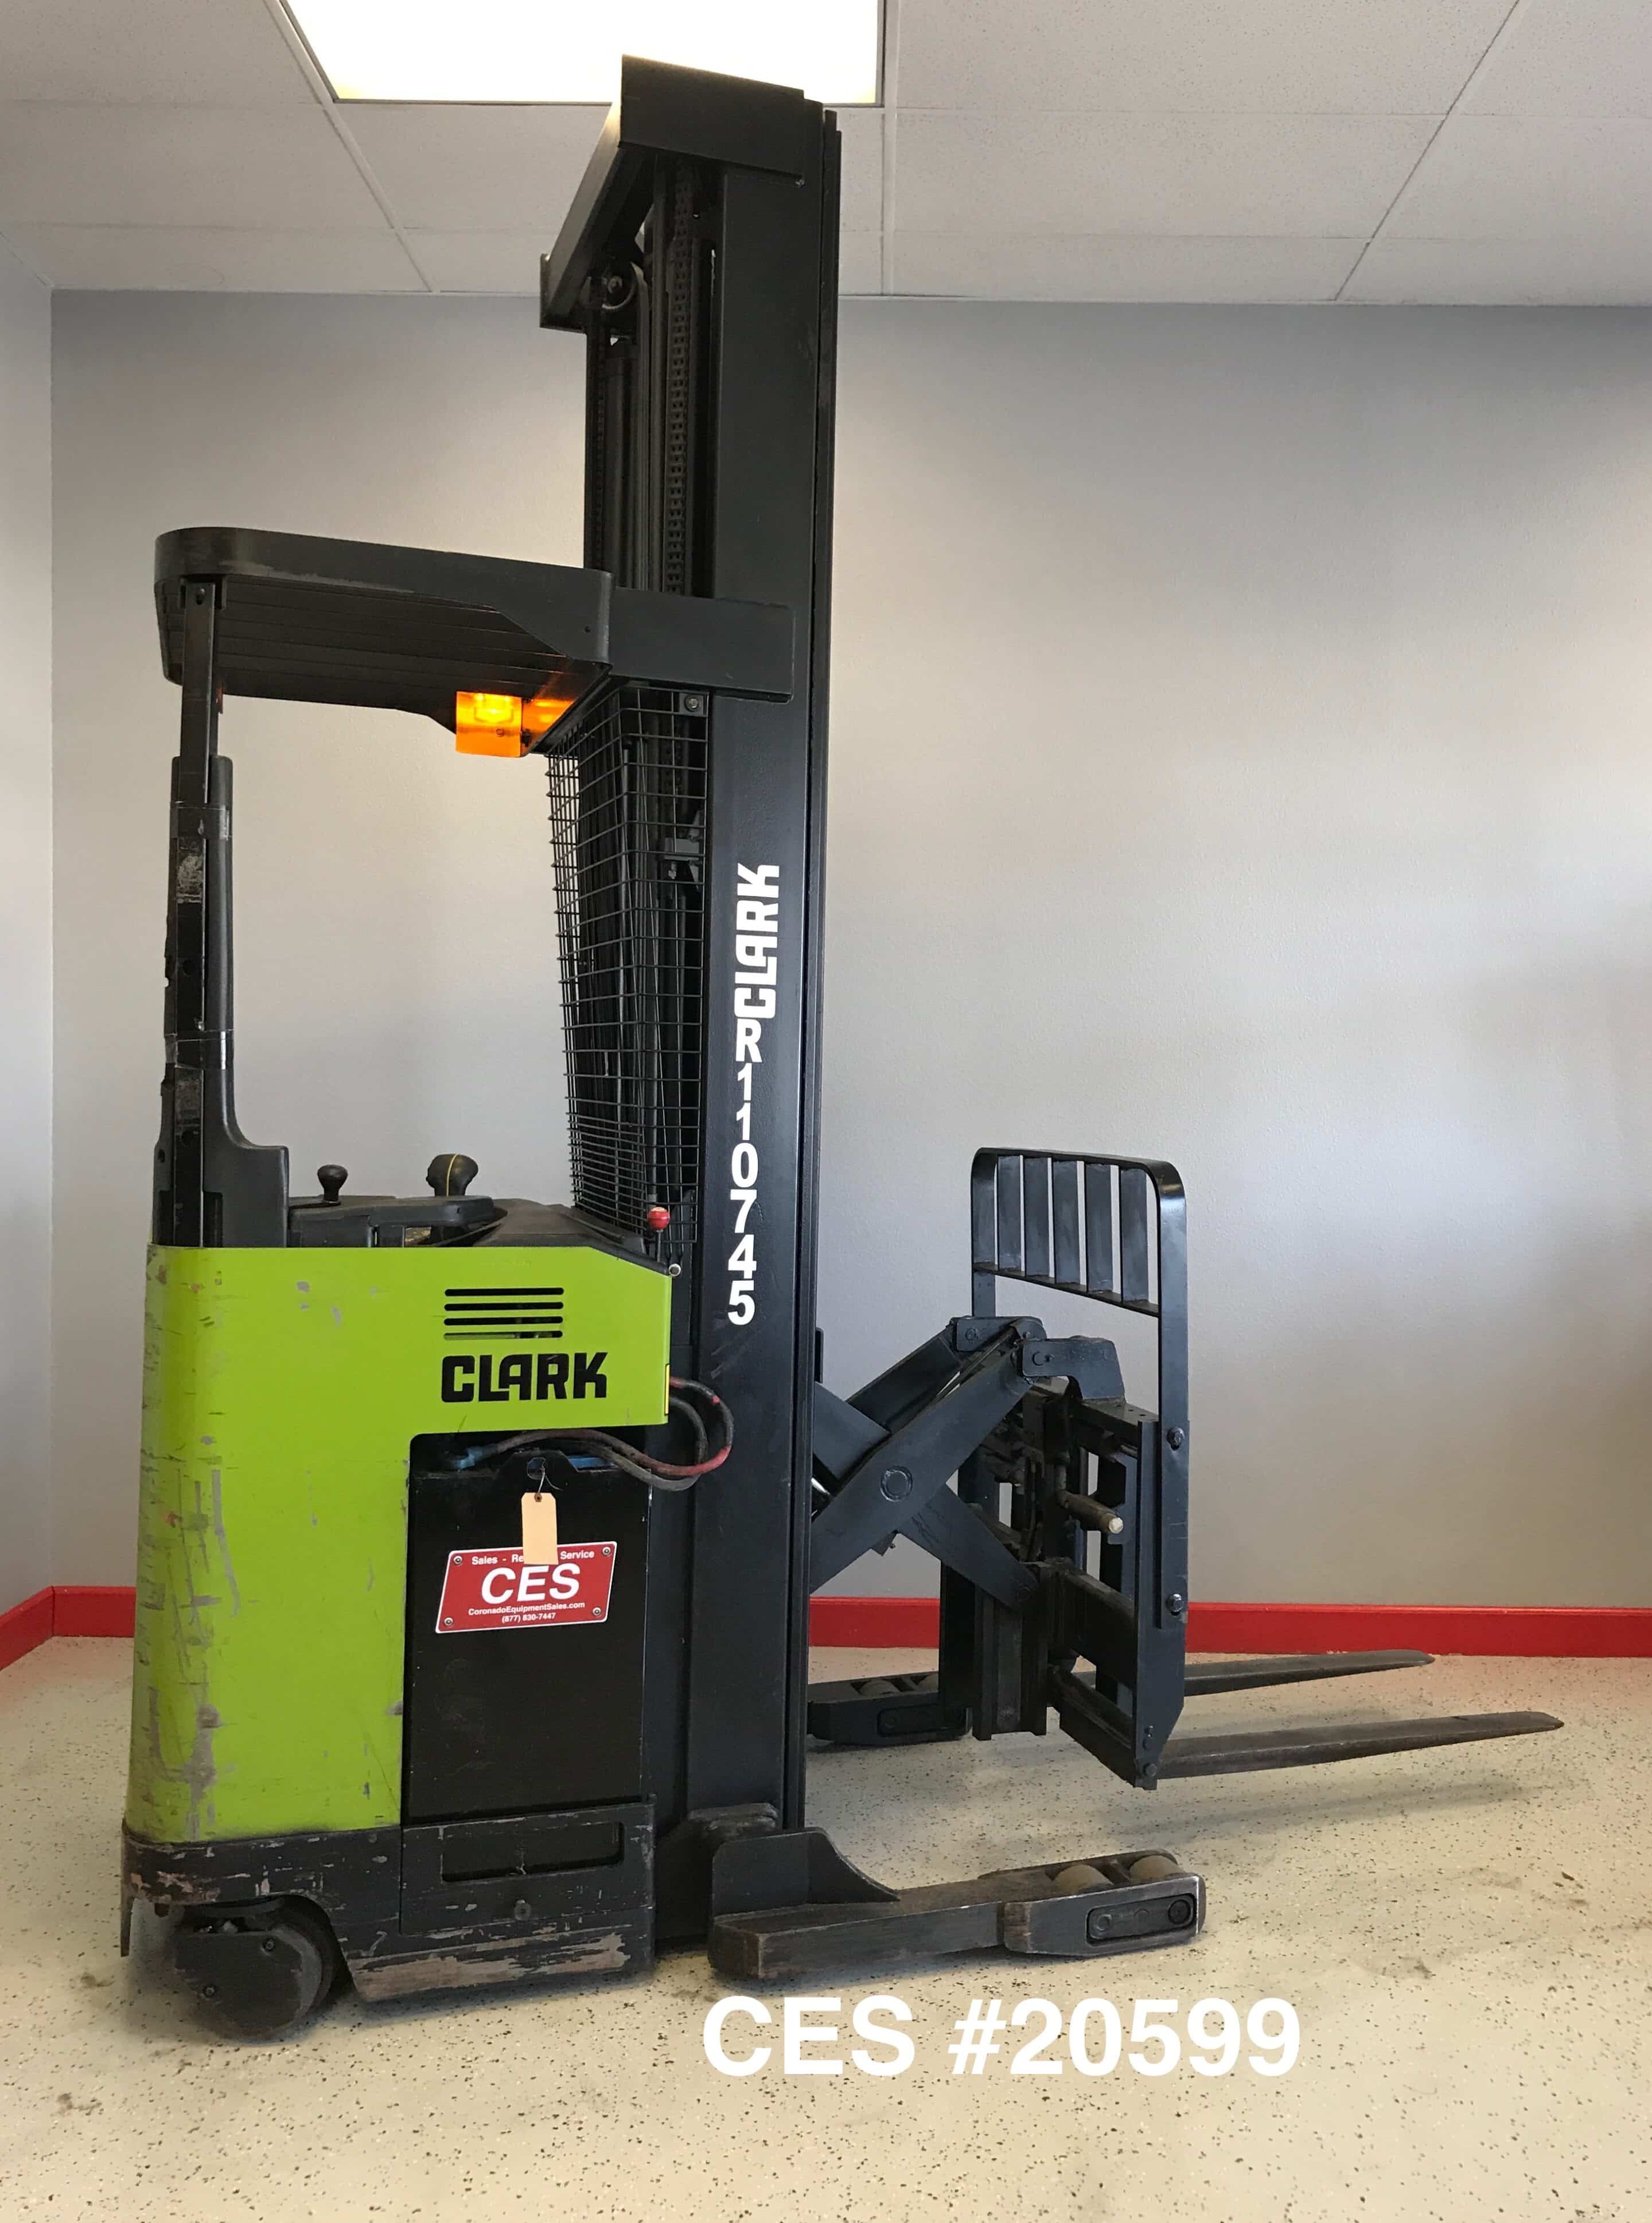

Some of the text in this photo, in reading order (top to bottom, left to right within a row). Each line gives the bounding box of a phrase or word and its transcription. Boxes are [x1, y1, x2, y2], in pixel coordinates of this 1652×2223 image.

[734, 862, 780, 1020] CLARK
[727, 1017, 763, 1326] R110745
[441, 1351, 609, 1403] CLARK
[472, 1555, 498, 1565] Sales
[560, 1550, 595, 1561] Service
[481, 1563, 581, 1605] CES
[468, 1602, 586, 1616] CoronadoEquipmentSales.com
[501, 1612, 556, 1624] (877) 830-7447
